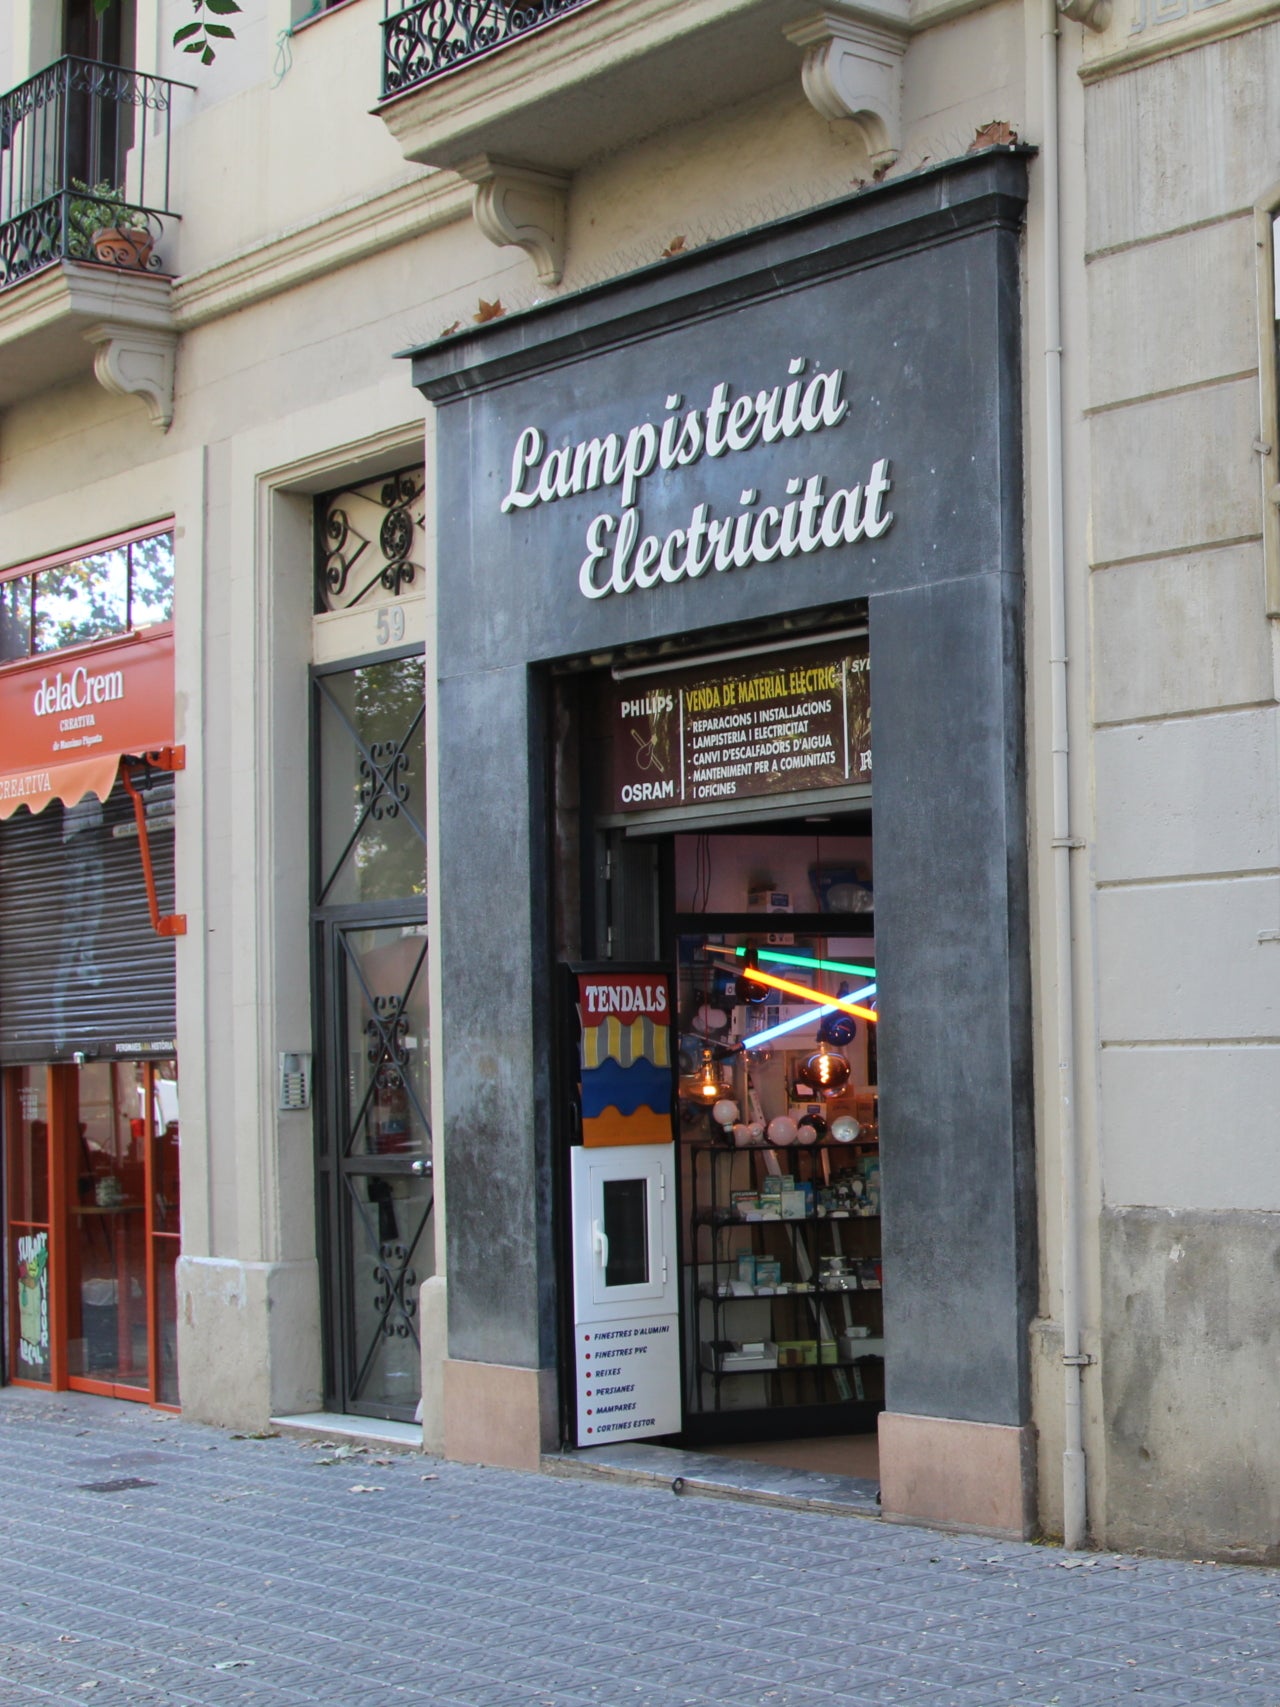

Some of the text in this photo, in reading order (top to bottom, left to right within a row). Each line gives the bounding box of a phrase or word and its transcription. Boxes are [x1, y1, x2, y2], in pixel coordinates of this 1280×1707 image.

[501, 356, 849, 514] Lampisteria
[579, 458, 894, 600] Electricitat
[375, 606, 405, 645] 59
[34, 666, 124, 717] delaCrem
[686, 686, 721, 713] VENDA
[723, 683, 736, 707] DE
[738, 673, 788, 704] MATERIAL
[621, 694, 674, 719] PHILIPS
[60, 714, 96, 732] CREATIVA
[692, 711, 752, 734] REPARACIONS
[753, 711, 758, 724] I
[692, 720, 809, 750] LAMPISTERIA I ELECTRICITAT
[693, 734, 832, 766] CANVI D'ESCALFADORS D'AIGUA
[692, 750, 836, 782] MANTENIMENT PER A COMUNITATS
[621, 780, 674, 803] OSRAM
[693, 781, 736, 799] I OFICINES
[585, 985, 667, 1013] TENDALS
[594, 1325, 670, 1341] FINESTRES D'ALUMINI
[594, 1345, 648, 1359] FINESTRES PVC
[595, 1367, 622, 1378] REIXES
[595, 1384, 635, 1396] PERSIANES
[596, 1402, 637, 1415] MAMPARES
[596, 1417, 656, 1433] CORTINES ESTOR
